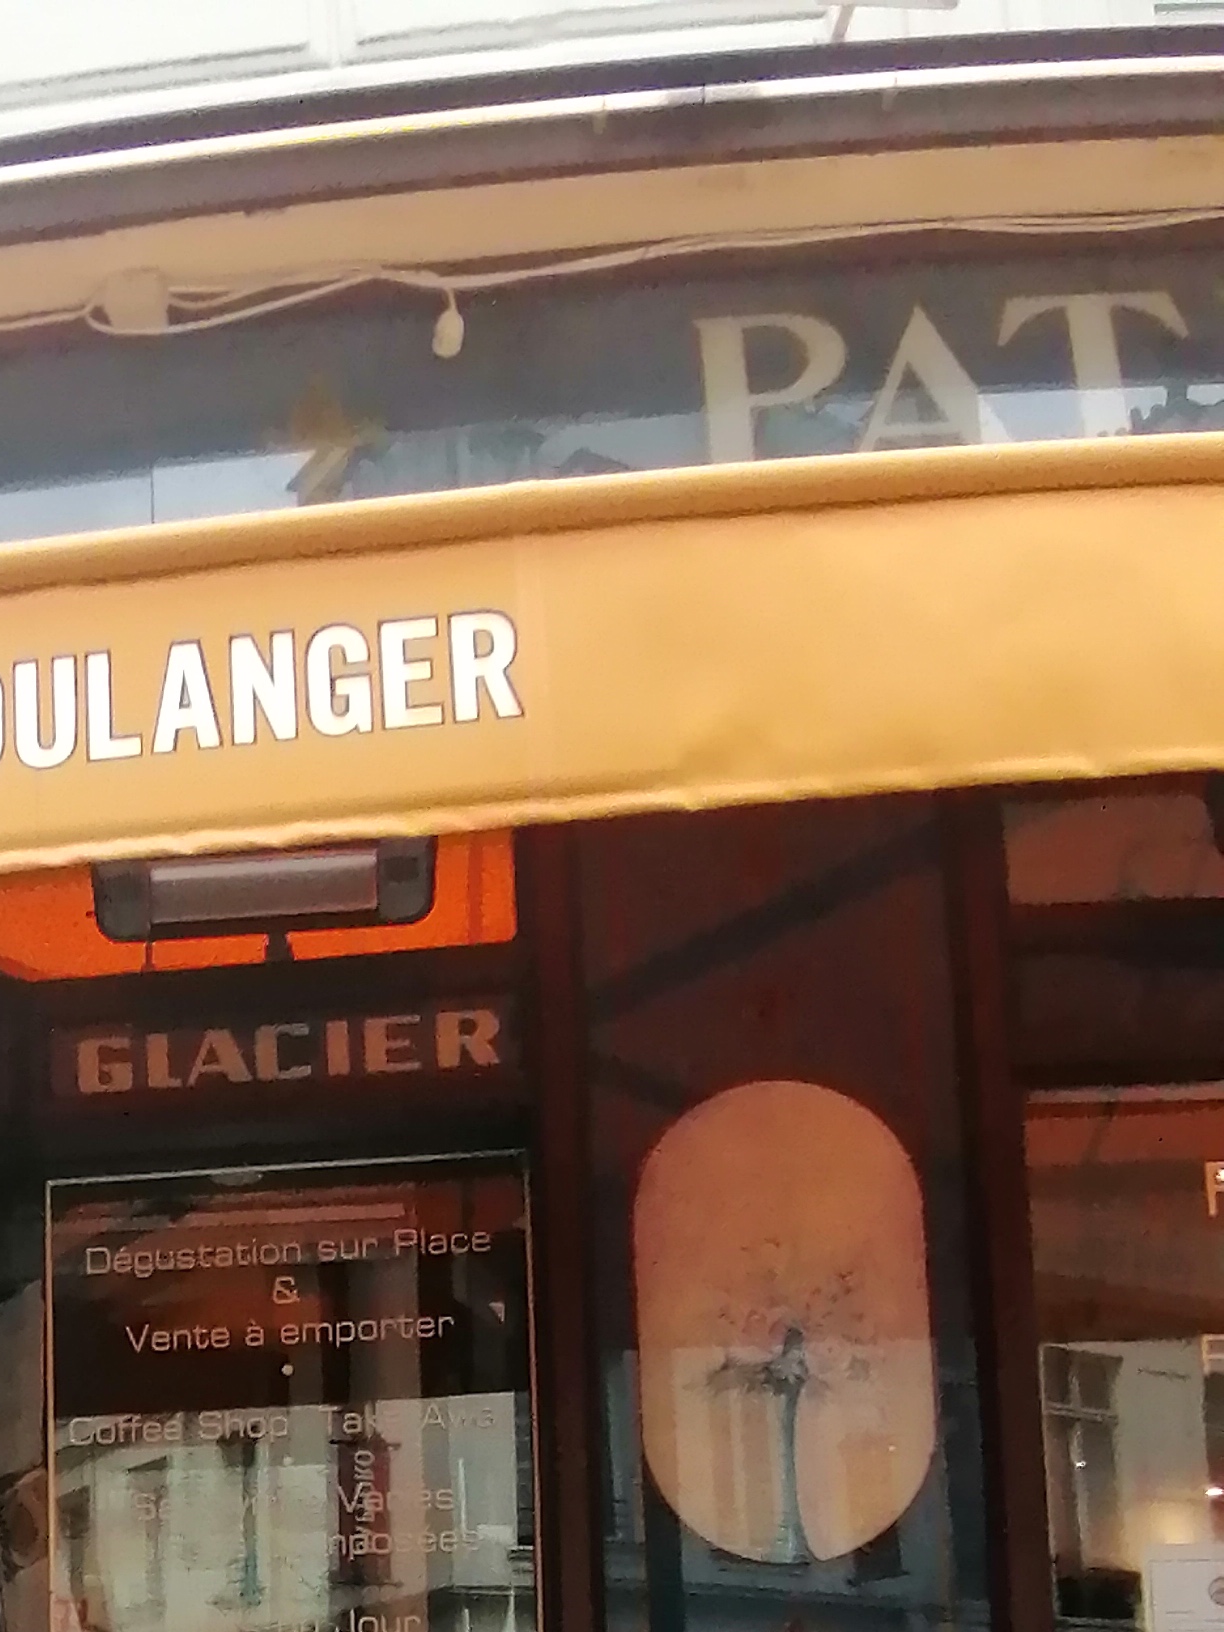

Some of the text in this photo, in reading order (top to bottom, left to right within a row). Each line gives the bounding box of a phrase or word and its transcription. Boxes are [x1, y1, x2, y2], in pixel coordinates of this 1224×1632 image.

[77, 1009, 501, 1095] GLACIER
[85, 1228, 493, 1279] Dégustation sur Place
[272, 1275, 301, 1305] &
[125, 1314, 455, 1354] Vente à emporter
[68, 1412, 182, 1446] Coffee
[197, 1408, 289, 1440] Shop
